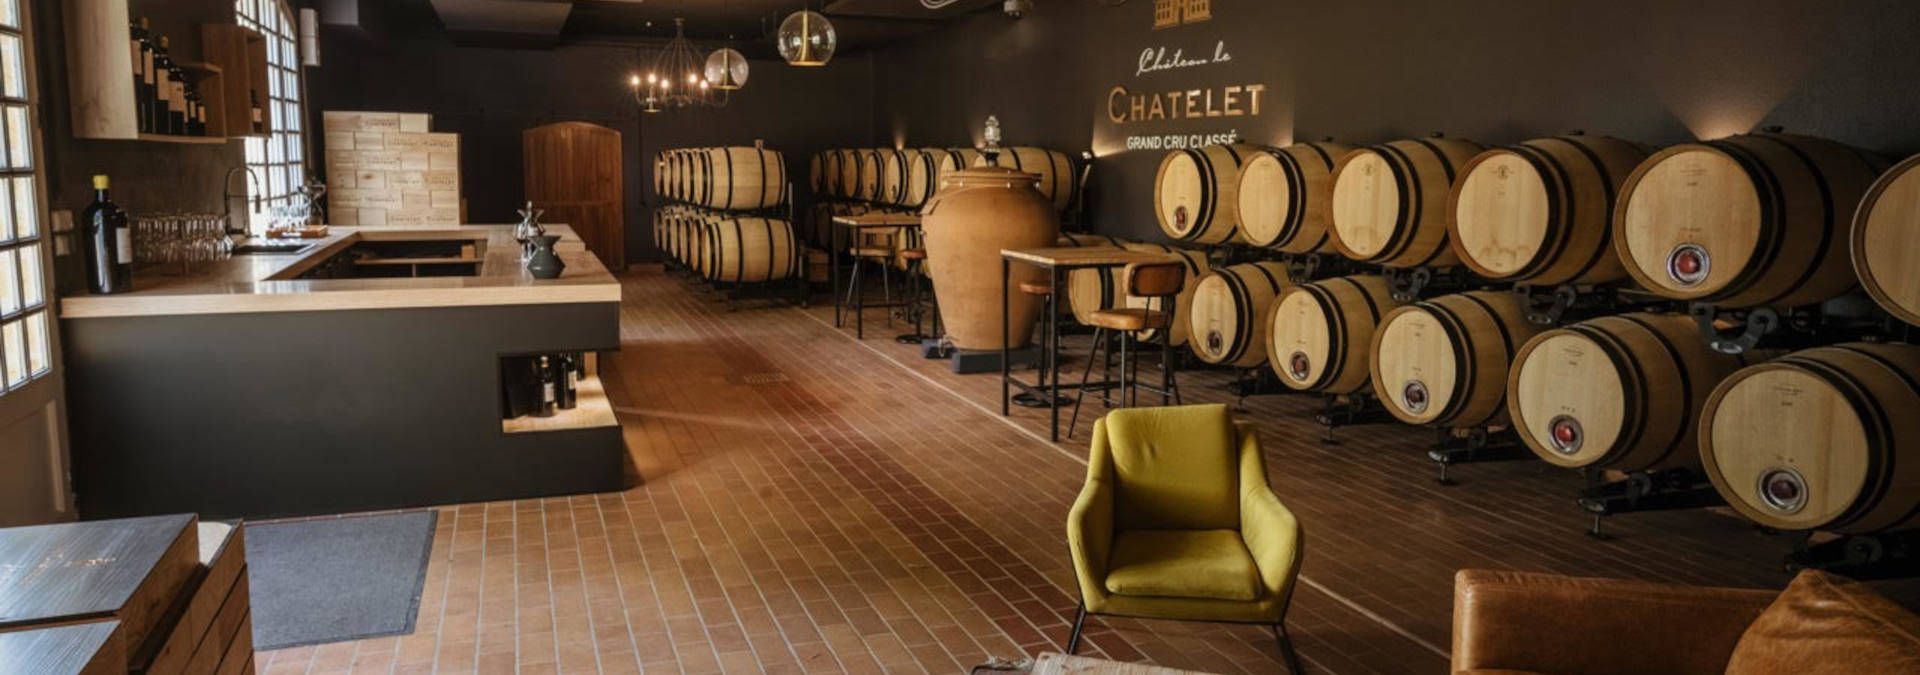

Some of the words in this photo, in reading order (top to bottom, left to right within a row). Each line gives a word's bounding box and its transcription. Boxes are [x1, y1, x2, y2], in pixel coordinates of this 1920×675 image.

[1212, 41, 1231, 63] le
[1108, 84, 1264, 124] CHATELET
[1127, 136, 1161, 150] GRAND
[1163, 135, 1187, 149] CRU
